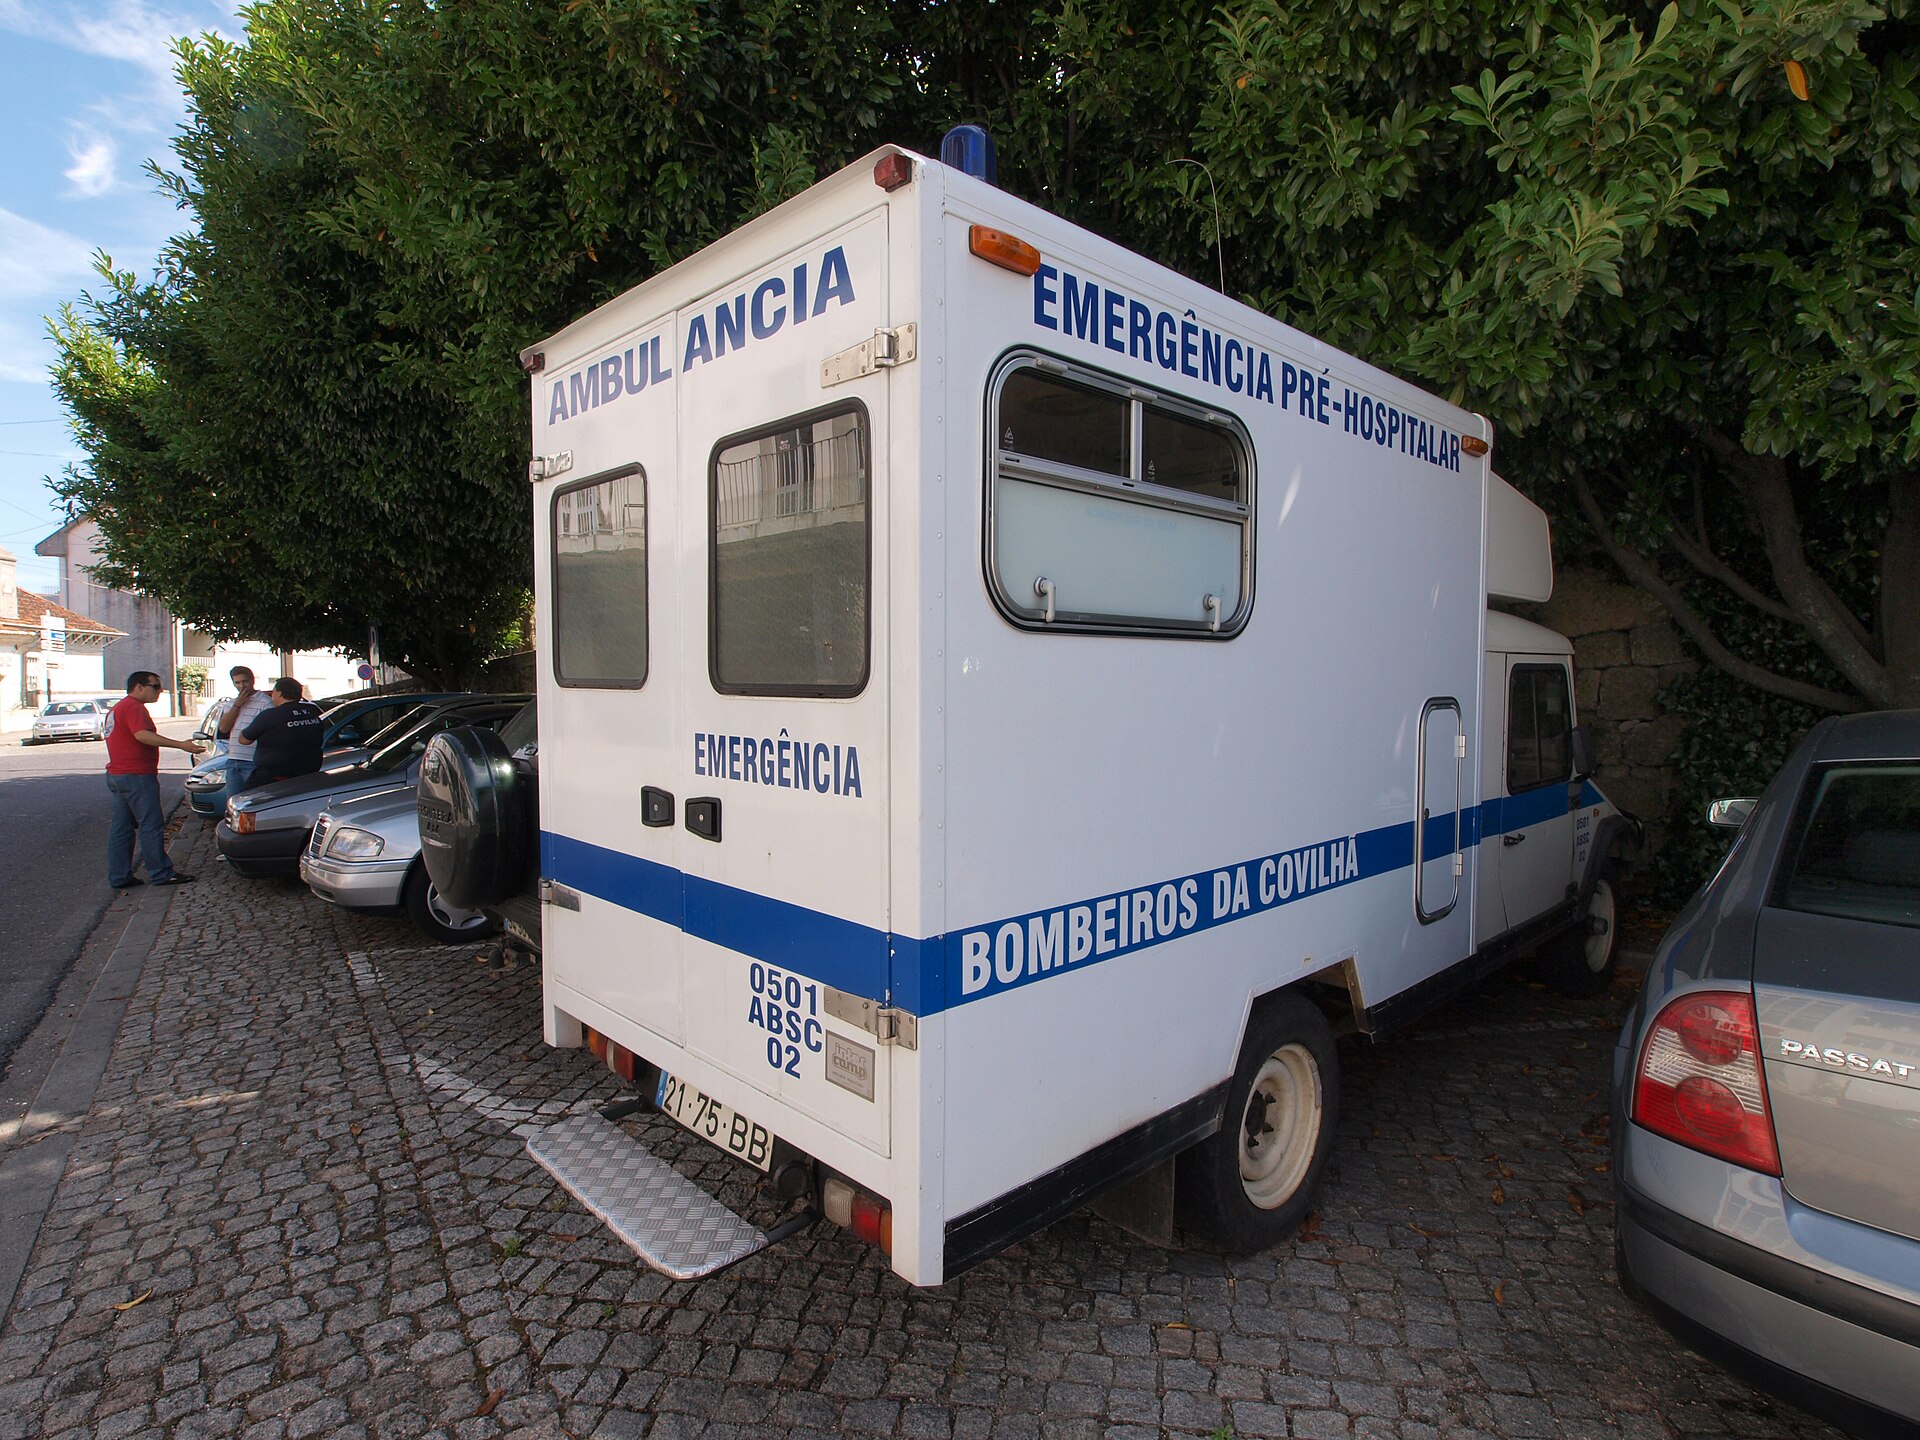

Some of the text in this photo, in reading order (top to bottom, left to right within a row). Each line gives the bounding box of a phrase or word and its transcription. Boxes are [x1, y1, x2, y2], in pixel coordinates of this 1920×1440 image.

[1033, 263, 1461, 474] EMERGÊNCIA PRÉ-HOSPITALAR
[694, 727, 863, 799] EMERGÊNCIA
[961, 877, 1199, 996] BOMBEIROS
[1212, 865, 1251, 920] DA
[749, 962, 817, 1017] 0501
[748, 995, 823, 1053] ABSC
[766, 1036, 801, 1080] 02
[1780, 1038, 1917, 1081] PASSAT
